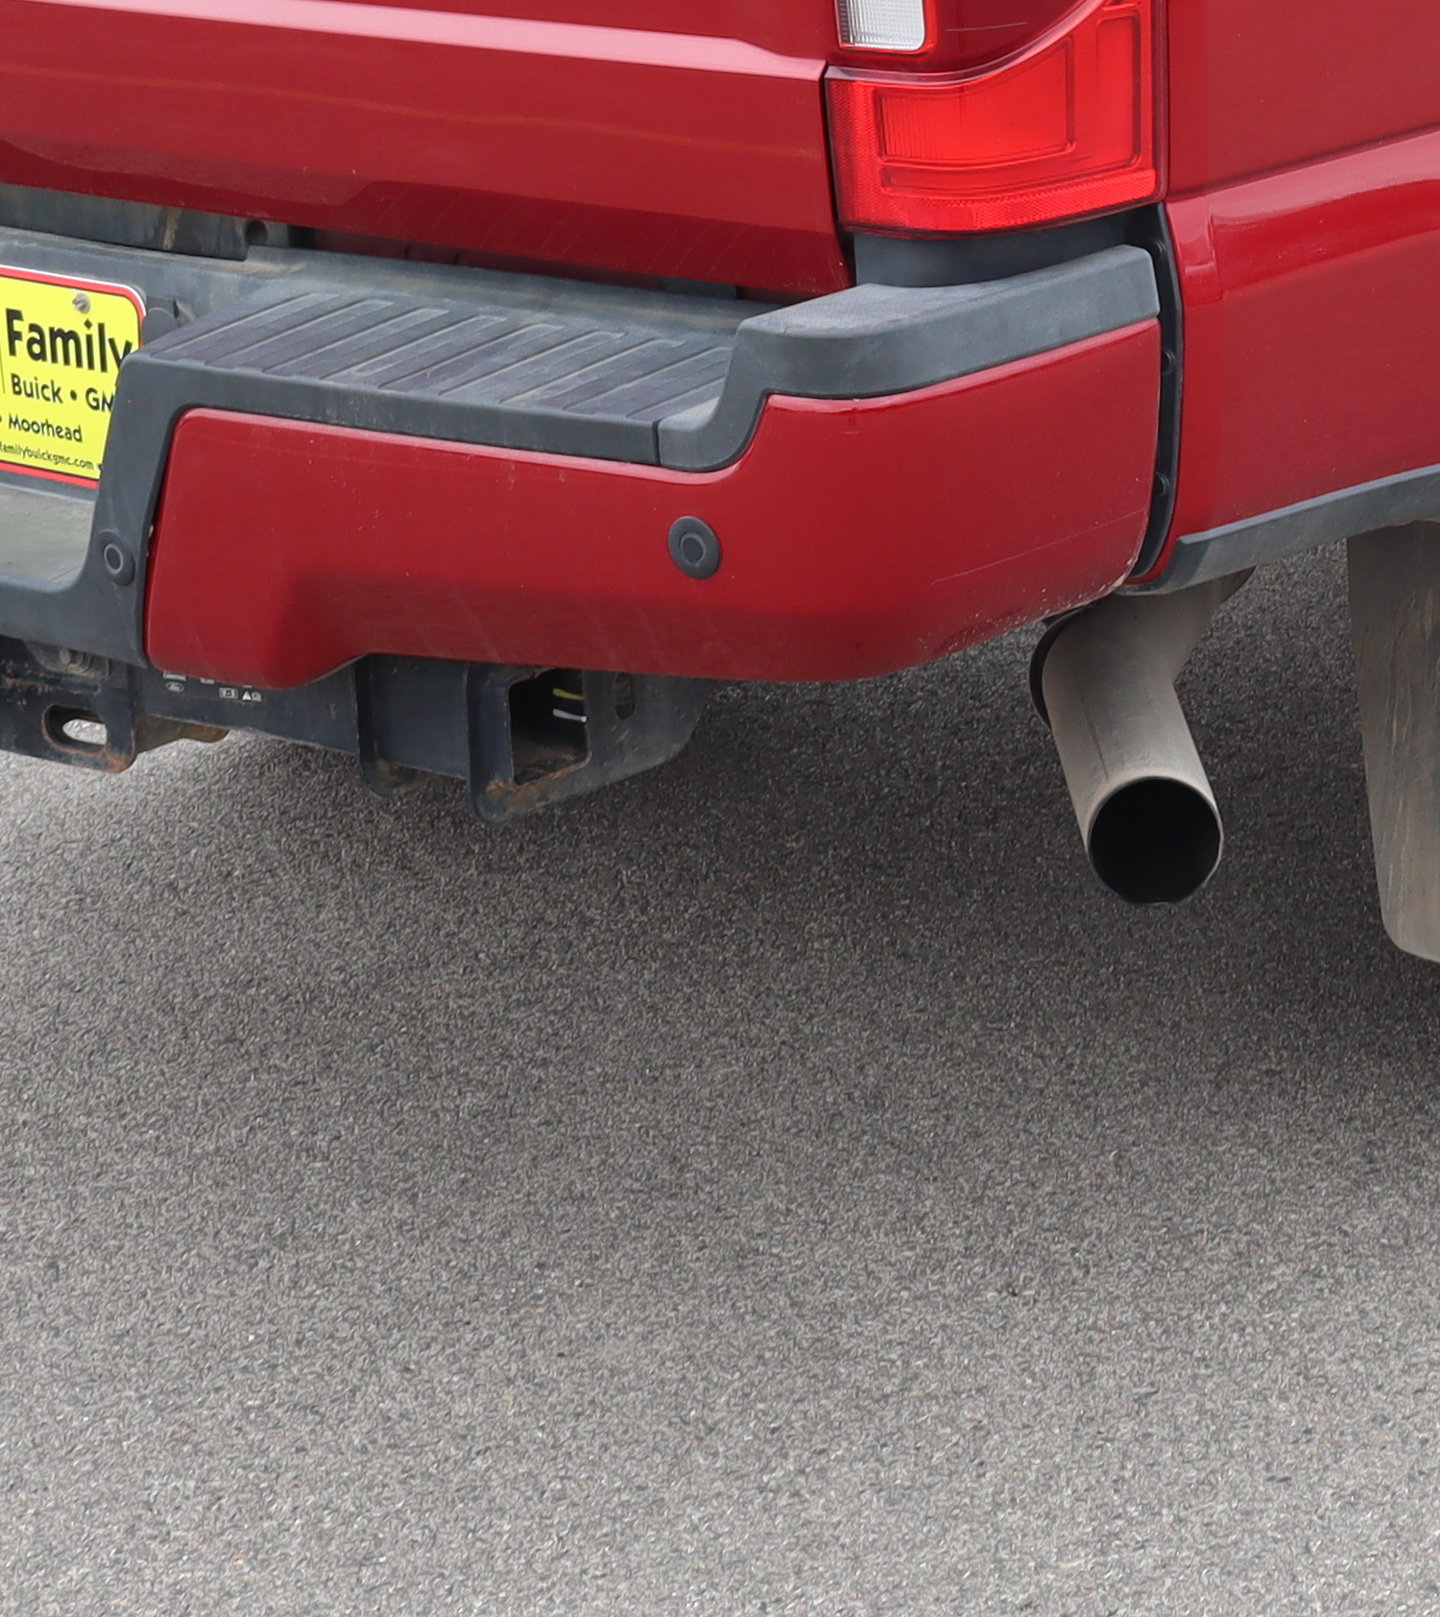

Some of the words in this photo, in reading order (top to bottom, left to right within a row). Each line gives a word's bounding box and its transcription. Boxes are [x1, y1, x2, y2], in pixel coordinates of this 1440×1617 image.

[5, 307, 133, 374] Family
[11, 373, 63, 404] Buick
[9, 412, 83, 443] Moorhead
